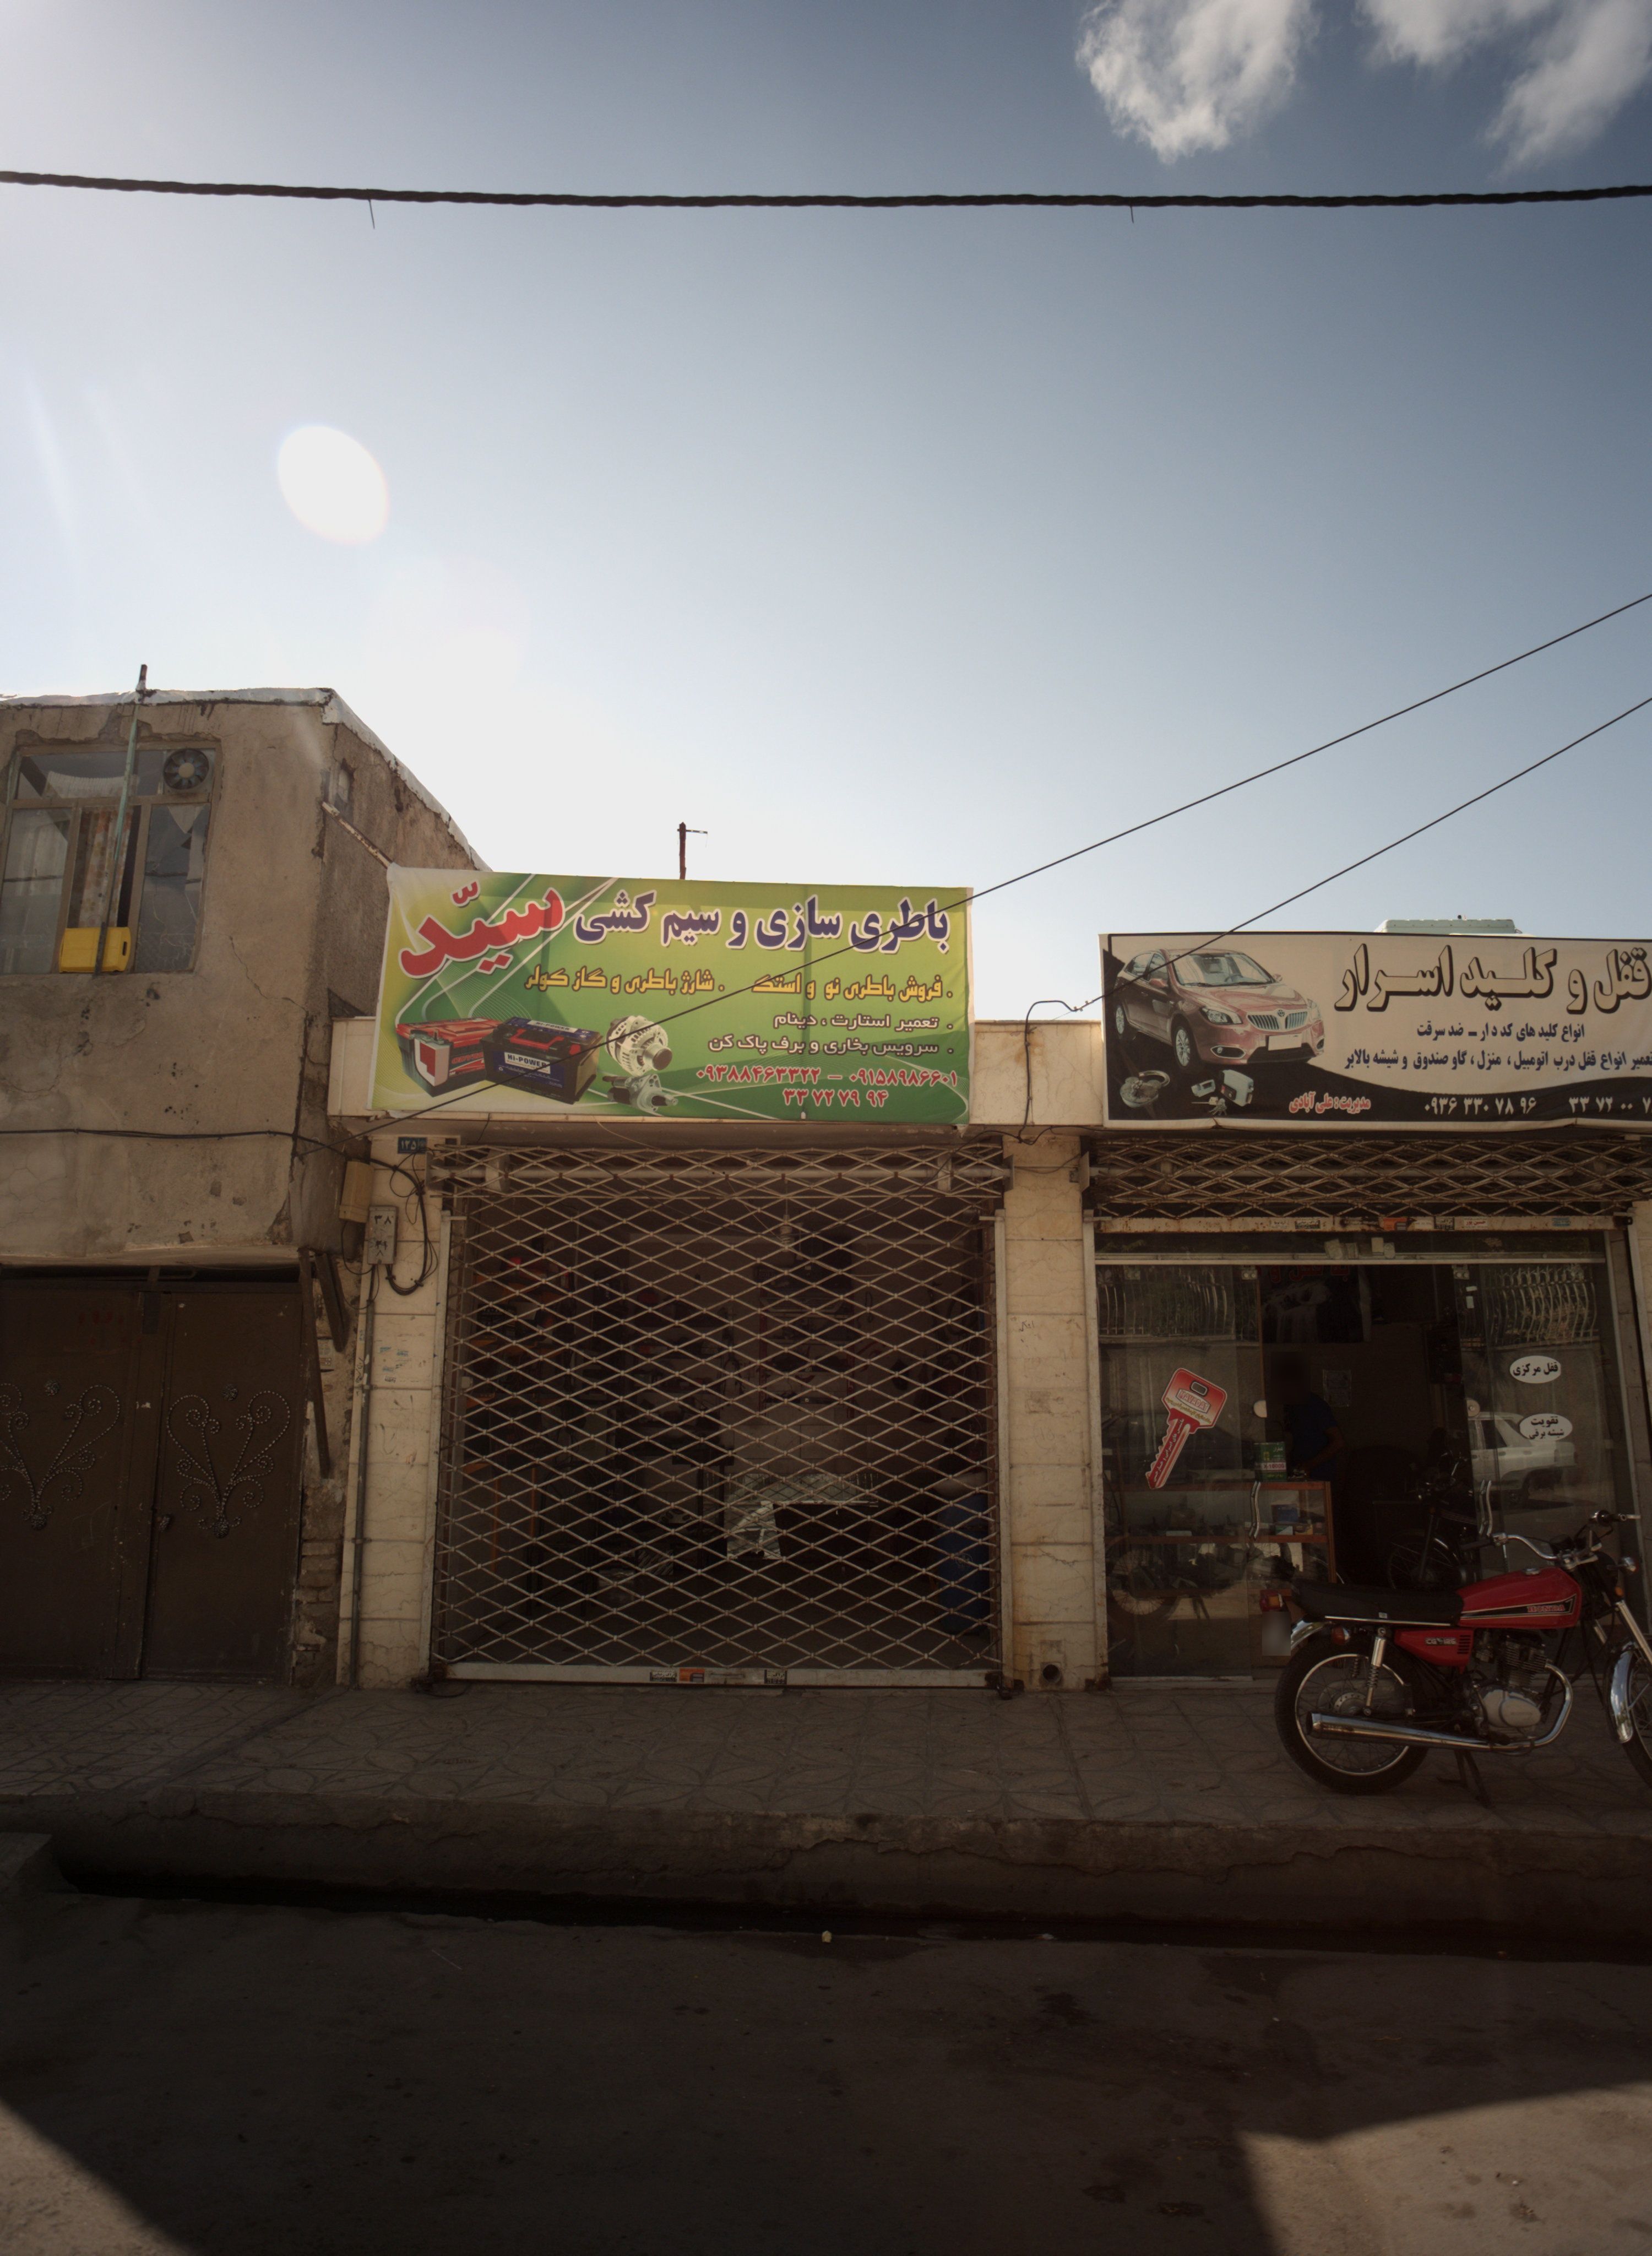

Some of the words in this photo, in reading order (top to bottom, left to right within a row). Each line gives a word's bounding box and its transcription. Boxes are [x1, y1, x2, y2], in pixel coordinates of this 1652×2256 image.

[574, 889, 657, 944] کشی
[661, 907, 722, 946] سیم
[754, 894, 843, 951] سازی
[850, 896, 950, 954] باطری
[726, 908, 749, 950] و
[525, 964, 569, 991] کولر
[572, 966, 607, 991] گاز
[611, 974, 620, 995] و
[624, 968, 678, 995] باطری
[681, 969, 715, 994] شارژ
[1334, 942, 1454, 1012] اسرار
[1459, 946, 1558, 1011] کلید
[1594, 947, 1652, 1014] قفل
[805, 980, 816, 1000] و
[824, 977, 840, 1000] نو
[845, 974, 896, 1001] باطری
[899, 975, 942, 1002] فروش
[1566, 969, 1588, 1015] و
[773, 1012, 817, 1028] دینام
[831, 1013, 890, 1030] استارت
[895, 1017, 939, 1031] تعمیر
[1448, 1022, 1464, 1037] ضد
[1500, 1022, 1513, 1038] کد
[1416, 1020, 1446, 1042] سرقت
[1516, 1022, 1536, 1042] های
[1538, 1023, 1558, 1042] کلید
[1561, 1023, 1585, 1042] انواع
[708, 1033, 734, 1053] کن
[737, 1034, 768, 1055] پاک
[771, 1036, 805, 1054] برف
[809, 1041, 819, 1055] و
[824, 1038, 869, 1056] بخاری
[873, 1042, 939, 1056] سرویس
[1344, 1048, 1371, 1069] بالابر
[1372, 1049, 1399, 1069] شیشه
[1401, 1055, 1408, 1070] و
[1413, 1050, 1449, 1070] صندوق
[1451, 1049, 1468, 1070] گاو
[1477, 1050, 1501, 1071] منزل
[1514, 1050, 1548, 1071] اتومبیل
[1553, 1055, 1576, 1071] درب
[1578, 1050, 1597, 1071] قفل
[1600, 1050, 1627, 1071] انواع
[782, 1088, 808, 1106] ۳۳
[812, 1089, 835, 1107] ۷۲
[838, 1089, 860, 1107] ۷۹
[866, 1089, 889, 1107] ۹۴
[1289, 1091, 1317, 1113] آبادی
[1424, 1096, 1458, 1115] ۰۹۳۶
[1463, 1097, 1489, 1115] ۳۳۰
[1495, 1097, 1514, 1115] ۷۸
[1520, 1096, 1537, 1114] ۹۶
[1569, 1096, 1590, 1114] ۳۳
[1513, 1363, 1541, 1376] مرکزی
[1543, 1362, 1558, 1375] قفل
[1530, 1416, 1559, 1428] تقویت
[1528, 1429, 1546, 1440] برقی
[1547, 1428, 1565, 1437] شیشه
[1527, 1604, 1566, 1613] HONDA
